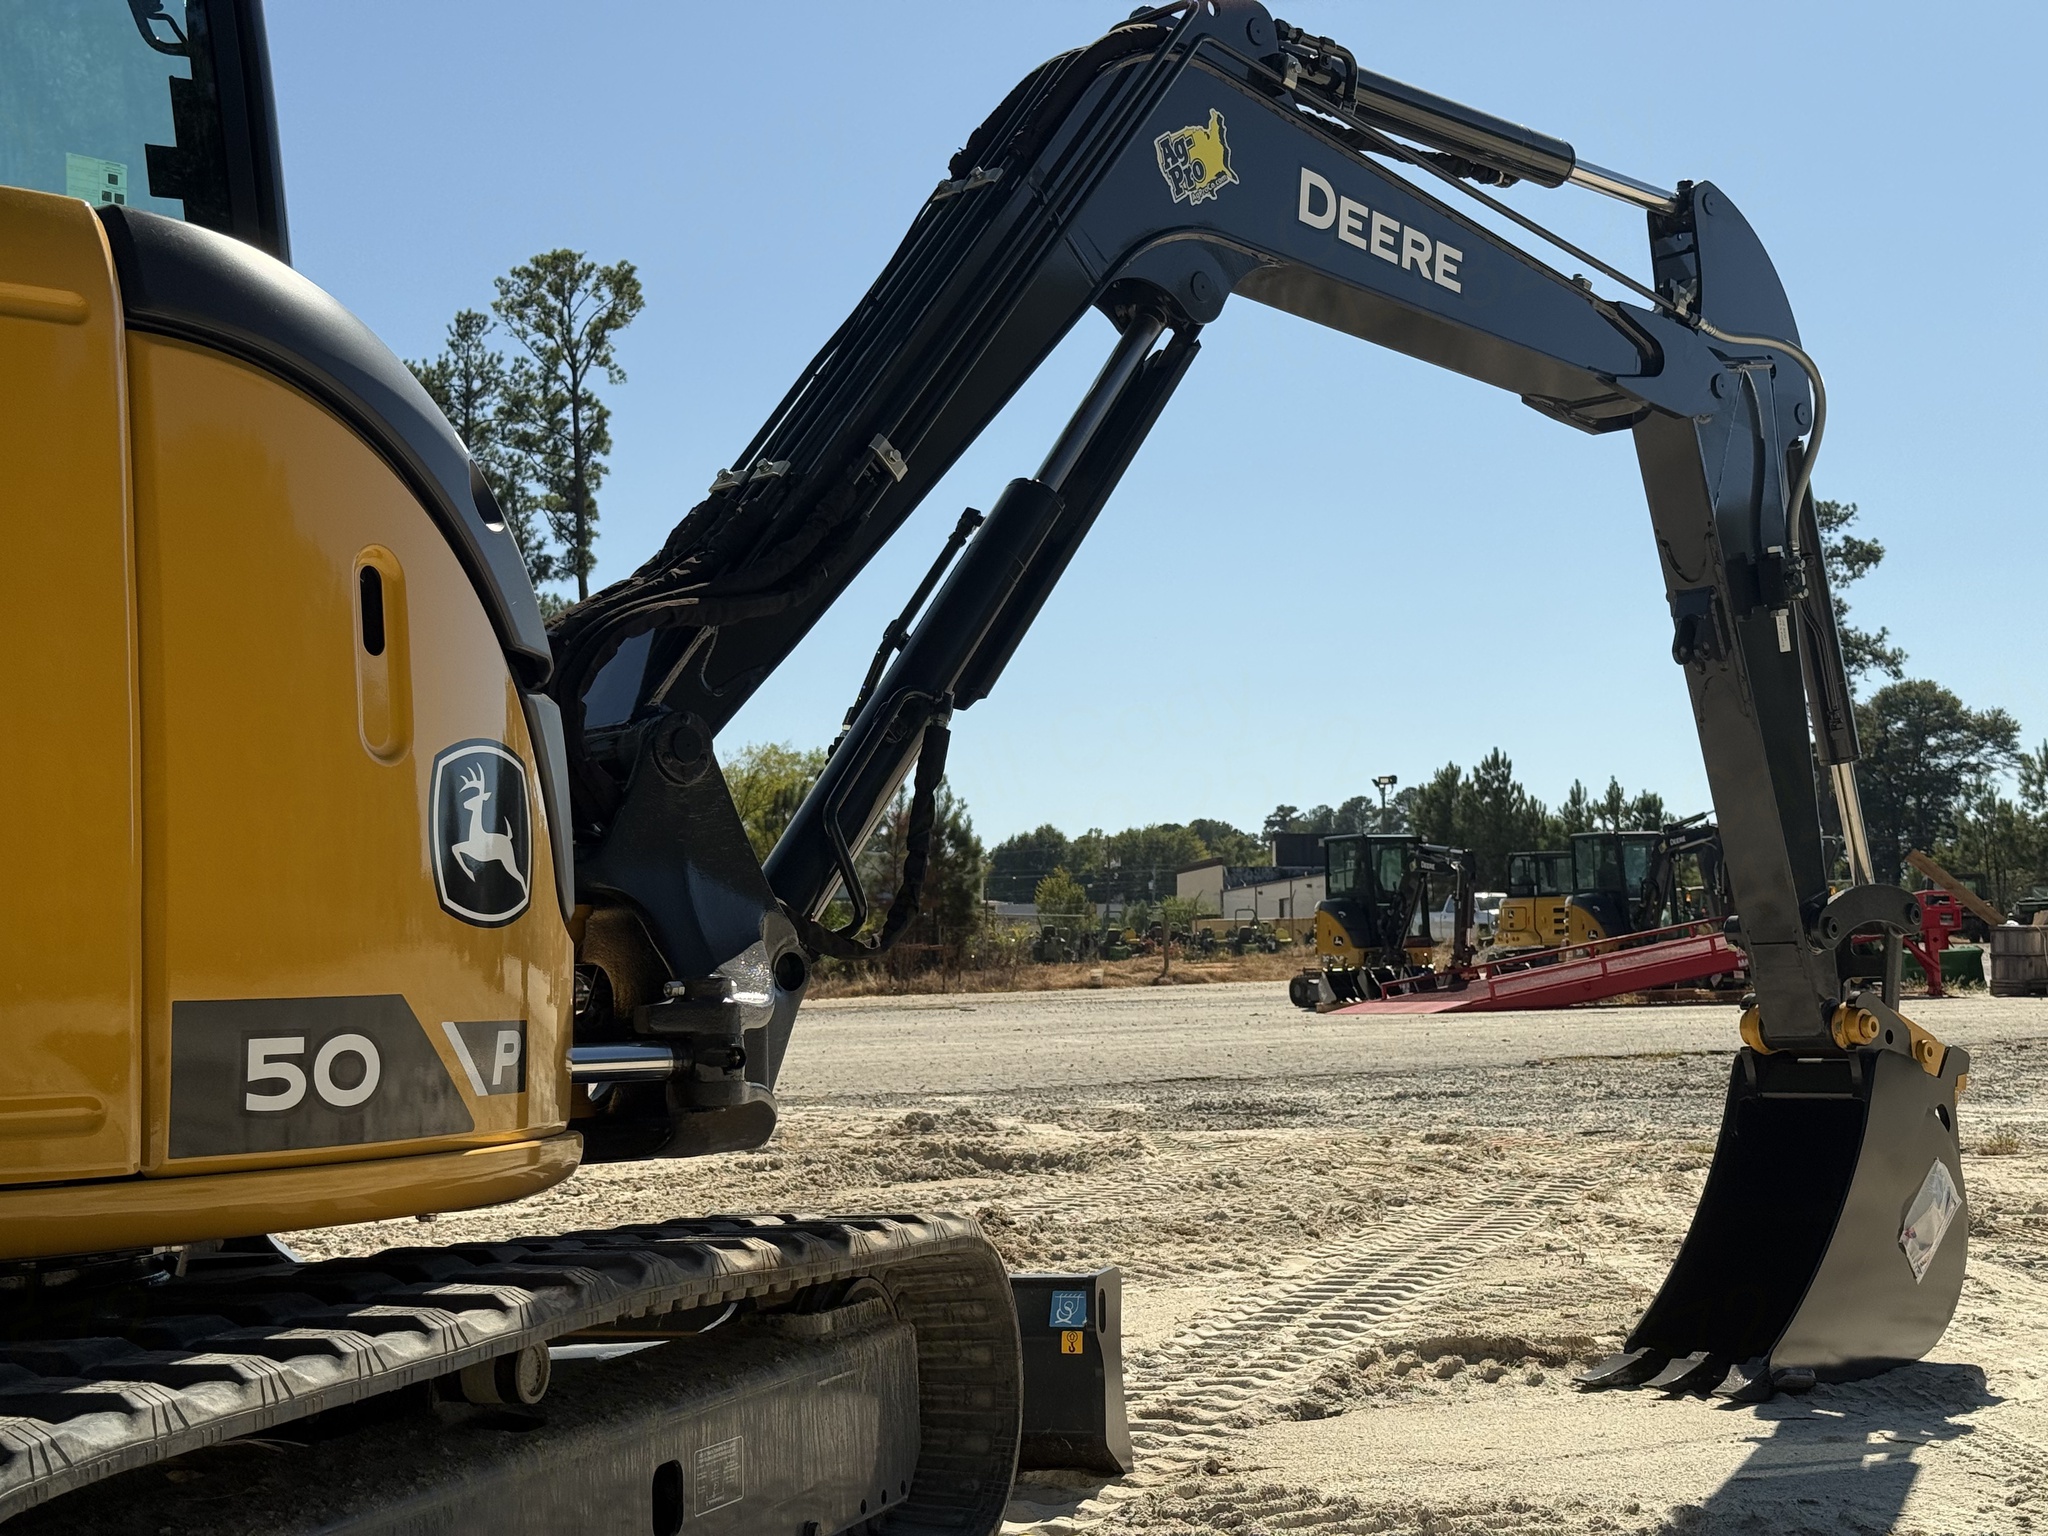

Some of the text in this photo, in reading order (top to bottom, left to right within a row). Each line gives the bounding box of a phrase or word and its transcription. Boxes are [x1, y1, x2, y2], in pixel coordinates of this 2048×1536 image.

[1159, 135, 1195, 171] Ag-
[1167, 158, 1206, 198] Pro
[1191, 174, 1229, 202] AgProCo.com
[1299, 166, 1464, 294] DEERE
[245, 1033, 382, 1112] 50
[492, 1029, 522, 1086] P
